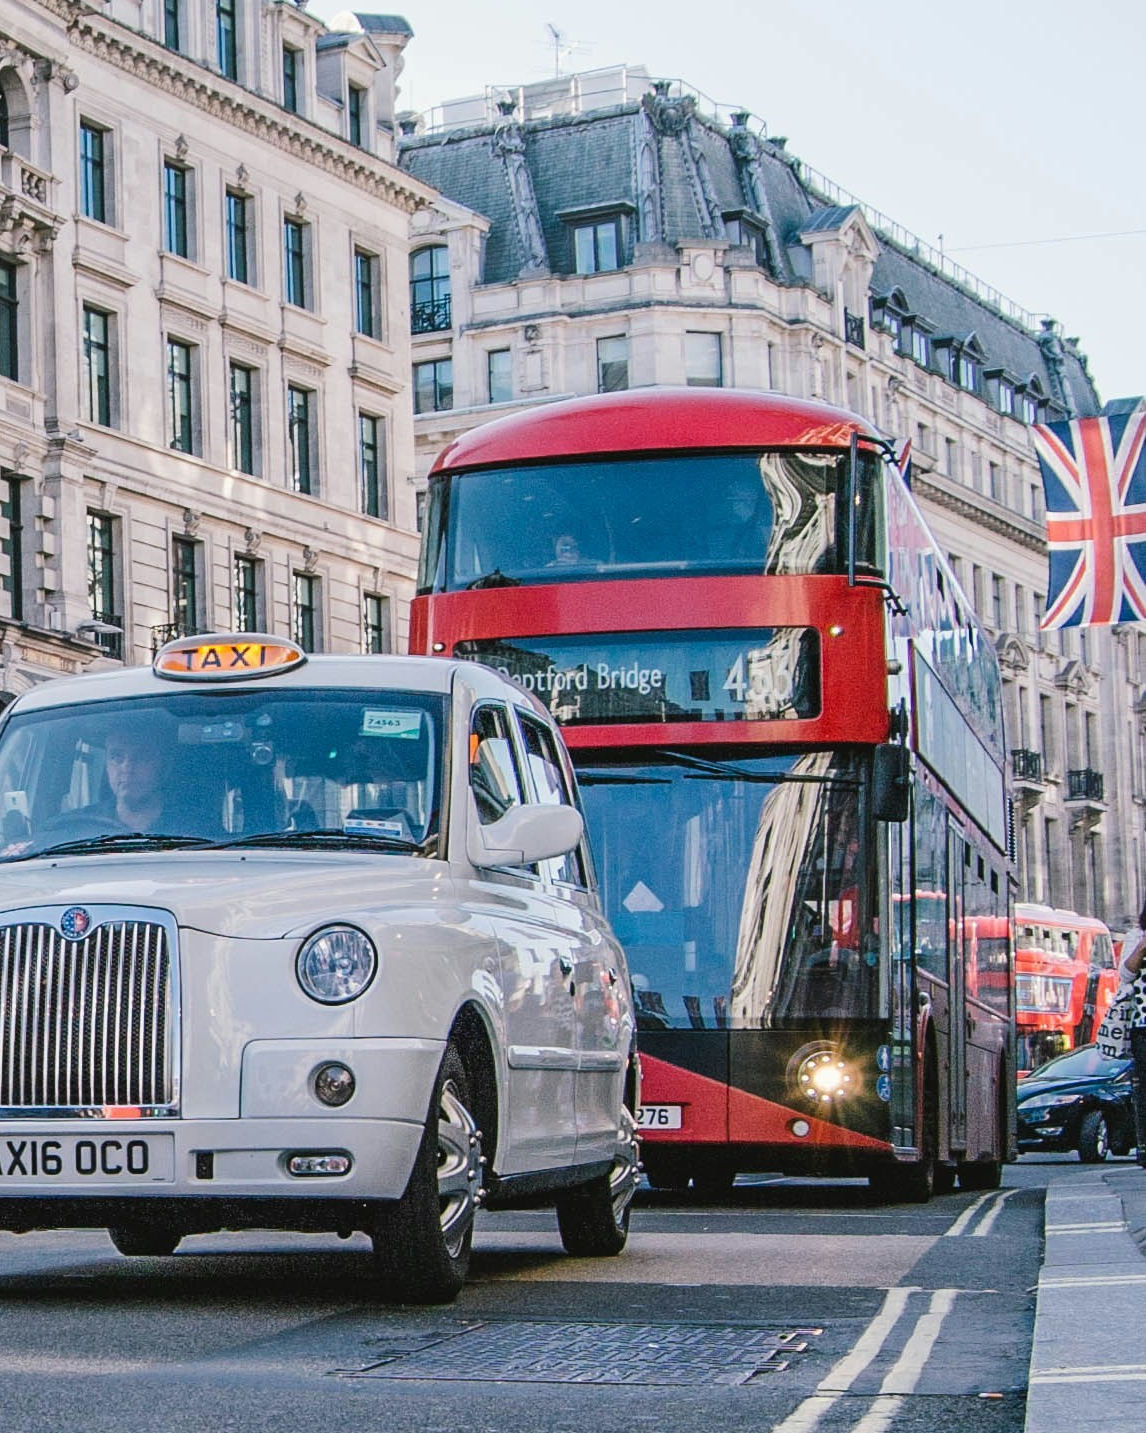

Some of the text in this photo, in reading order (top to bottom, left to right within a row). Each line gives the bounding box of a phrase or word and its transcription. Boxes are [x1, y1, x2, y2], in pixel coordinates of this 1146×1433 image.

[182, 646, 266, 670] TAXI
[597, 662, 662, 694] Bridge
[75, 1140, 149, 1175] OCO
